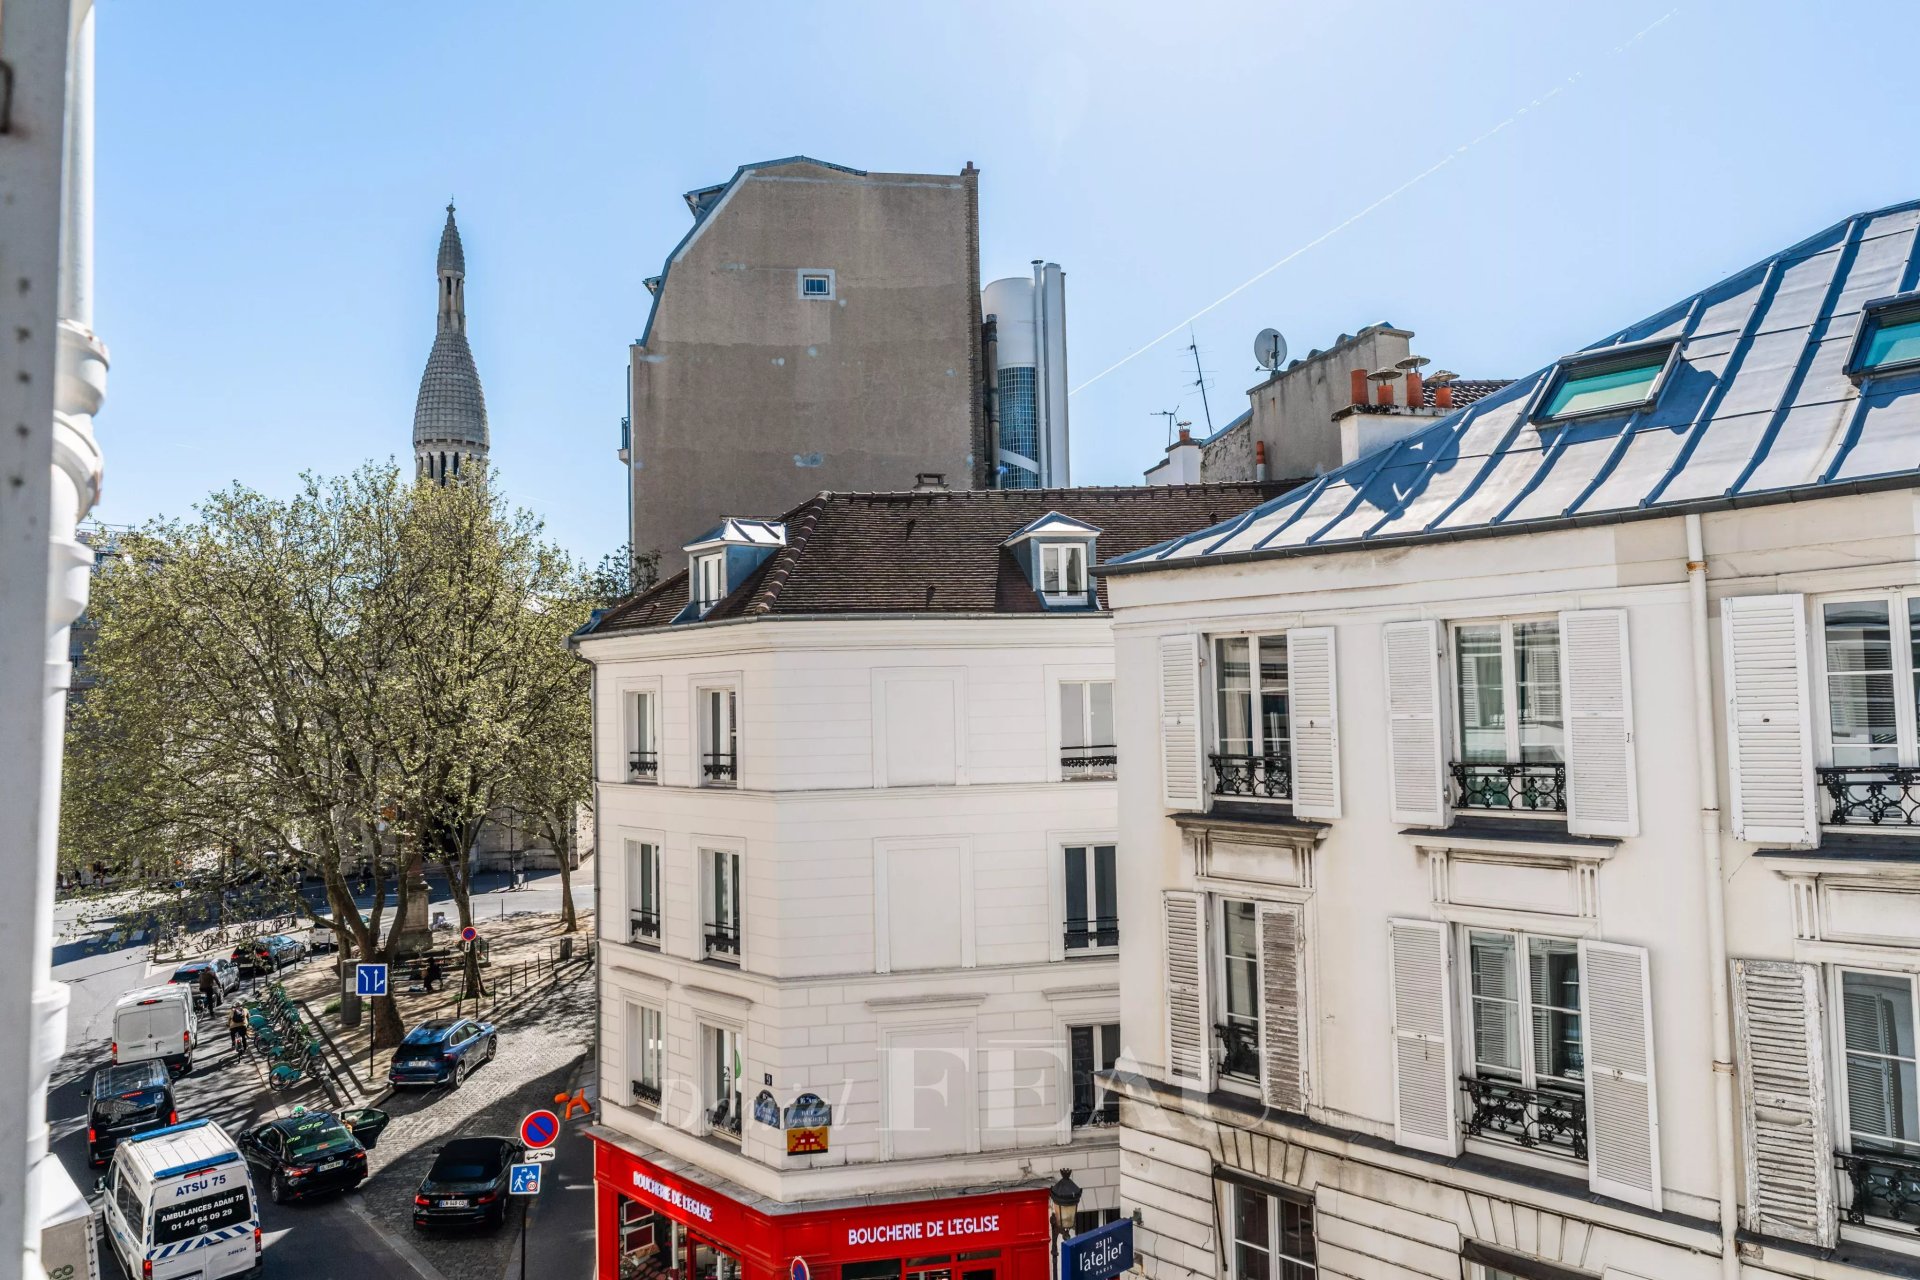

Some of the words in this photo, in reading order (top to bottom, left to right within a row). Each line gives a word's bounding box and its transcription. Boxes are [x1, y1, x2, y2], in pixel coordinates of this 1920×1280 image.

[175, 1180, 208, 1197] ATSU
[212, 1174, 226, 1187] 75
[633, 1171, 671, 1202] BOUCHERIE
[671, 1189, 683, 1208] DE
[161, 1202, 213, 1223] AMBULANCES
[213, 1196, 234, 1208] ADAM
[235, 1193, 245, 1202] 75
[171, 1222, 182, 1231] 01
[184, 1218, 196, 1228] 44
[197, 1214, 208, 1224] 64
[210, 1211, 221, 1220] 09
[222, 1208, 233, 1217] 29
[848, 1222, 923, 1246] BOUCHERIE
[926, 1220, 944, 1238] DE
[1079, 1238, 1124, 1272] l'atelier
[1095, 1265, 1113, 1276] PARIS
